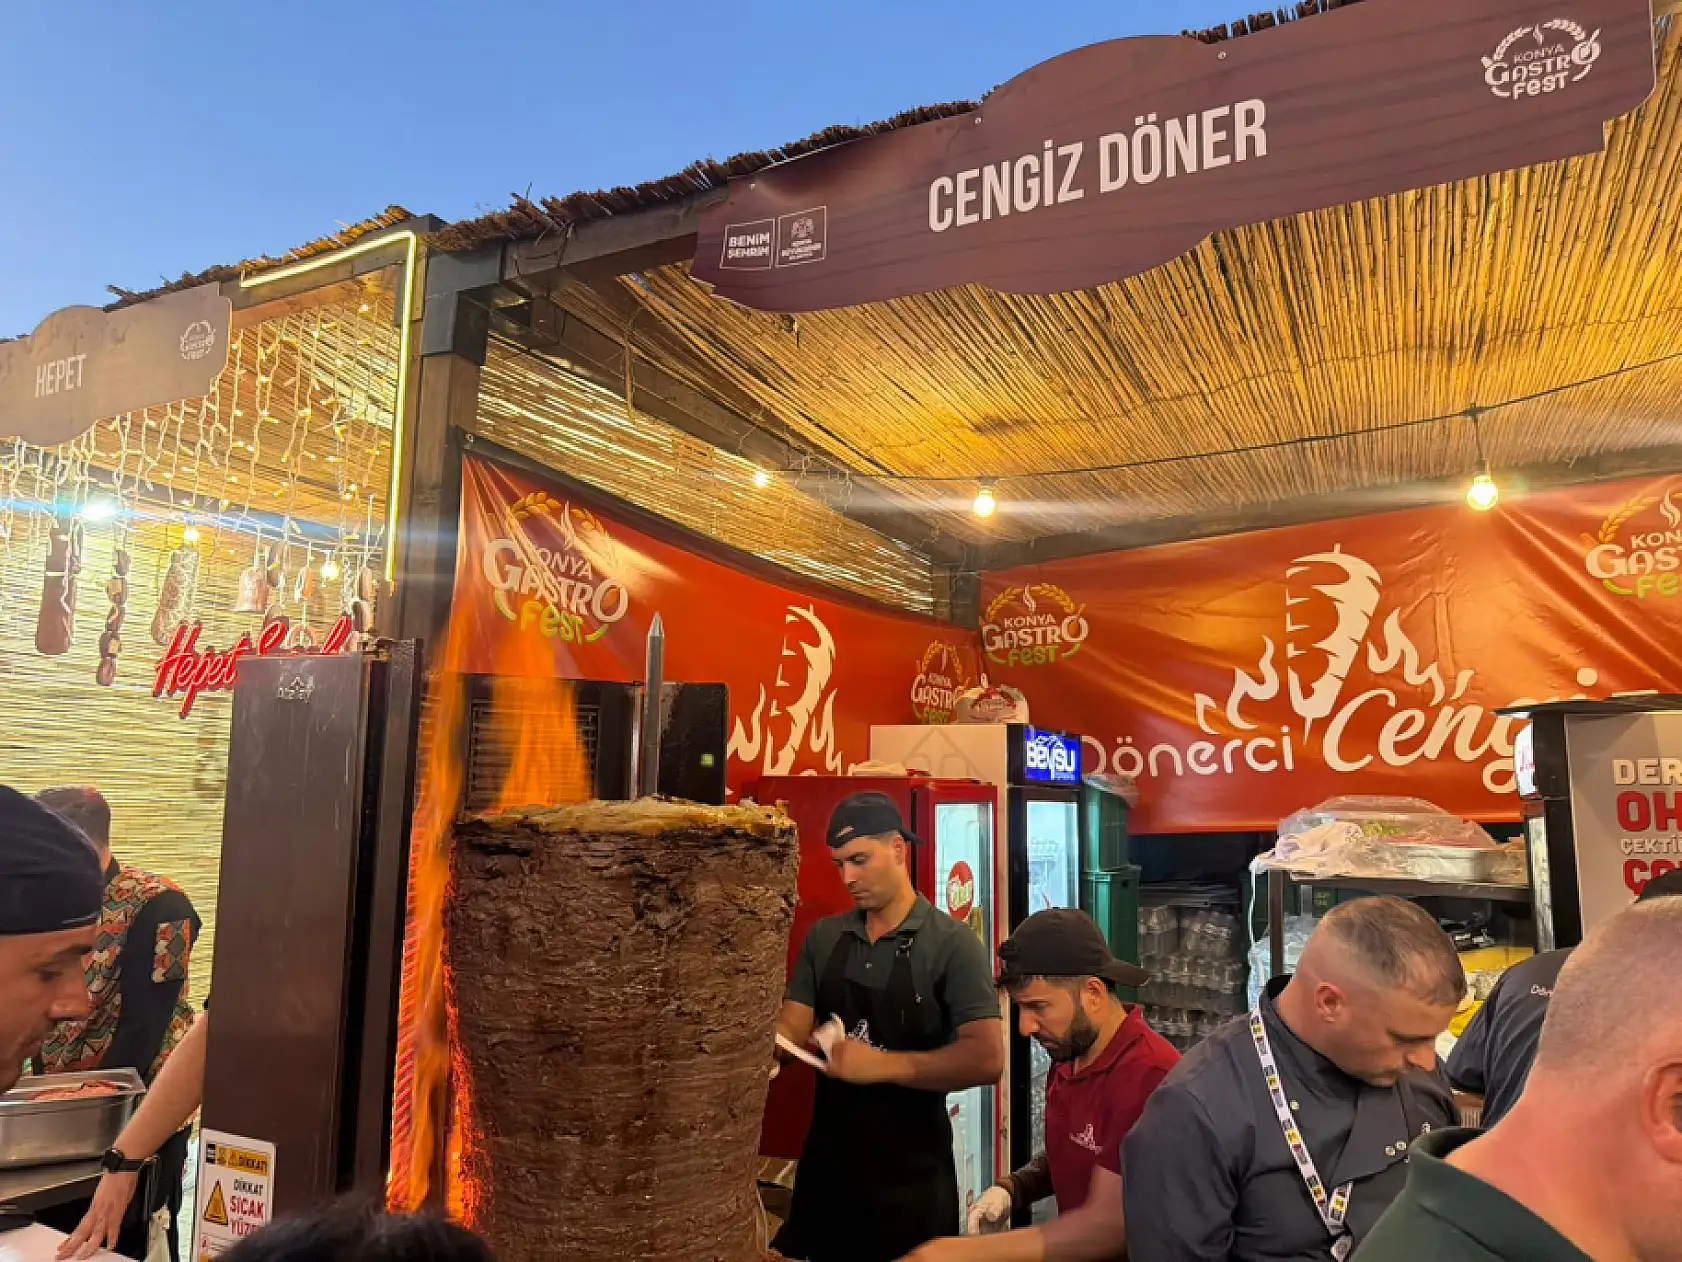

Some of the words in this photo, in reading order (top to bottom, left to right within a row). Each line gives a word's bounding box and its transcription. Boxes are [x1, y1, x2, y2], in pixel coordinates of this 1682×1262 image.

[928, 139, 1085, 232] CENGİZ
[1099, 98, 1267, 194] DÖNER
[34, 353, 87, 398] HEPET
[1630, 530, 1682, 549] KON
[1585, 544, 1682, 579] GAS
[1636, 573, 1682, 599] Fe
[982, 615, 1088, 652] GASTRO
[1004, 613, 1057, 629] KONYA
[153, 620, 251, 719] Hepet
[1612, 757, 1682, 785] DER
[1621, 835, 1682, 855] ÇEKTİ
[230, 1196, 265, 1220] SICAK
